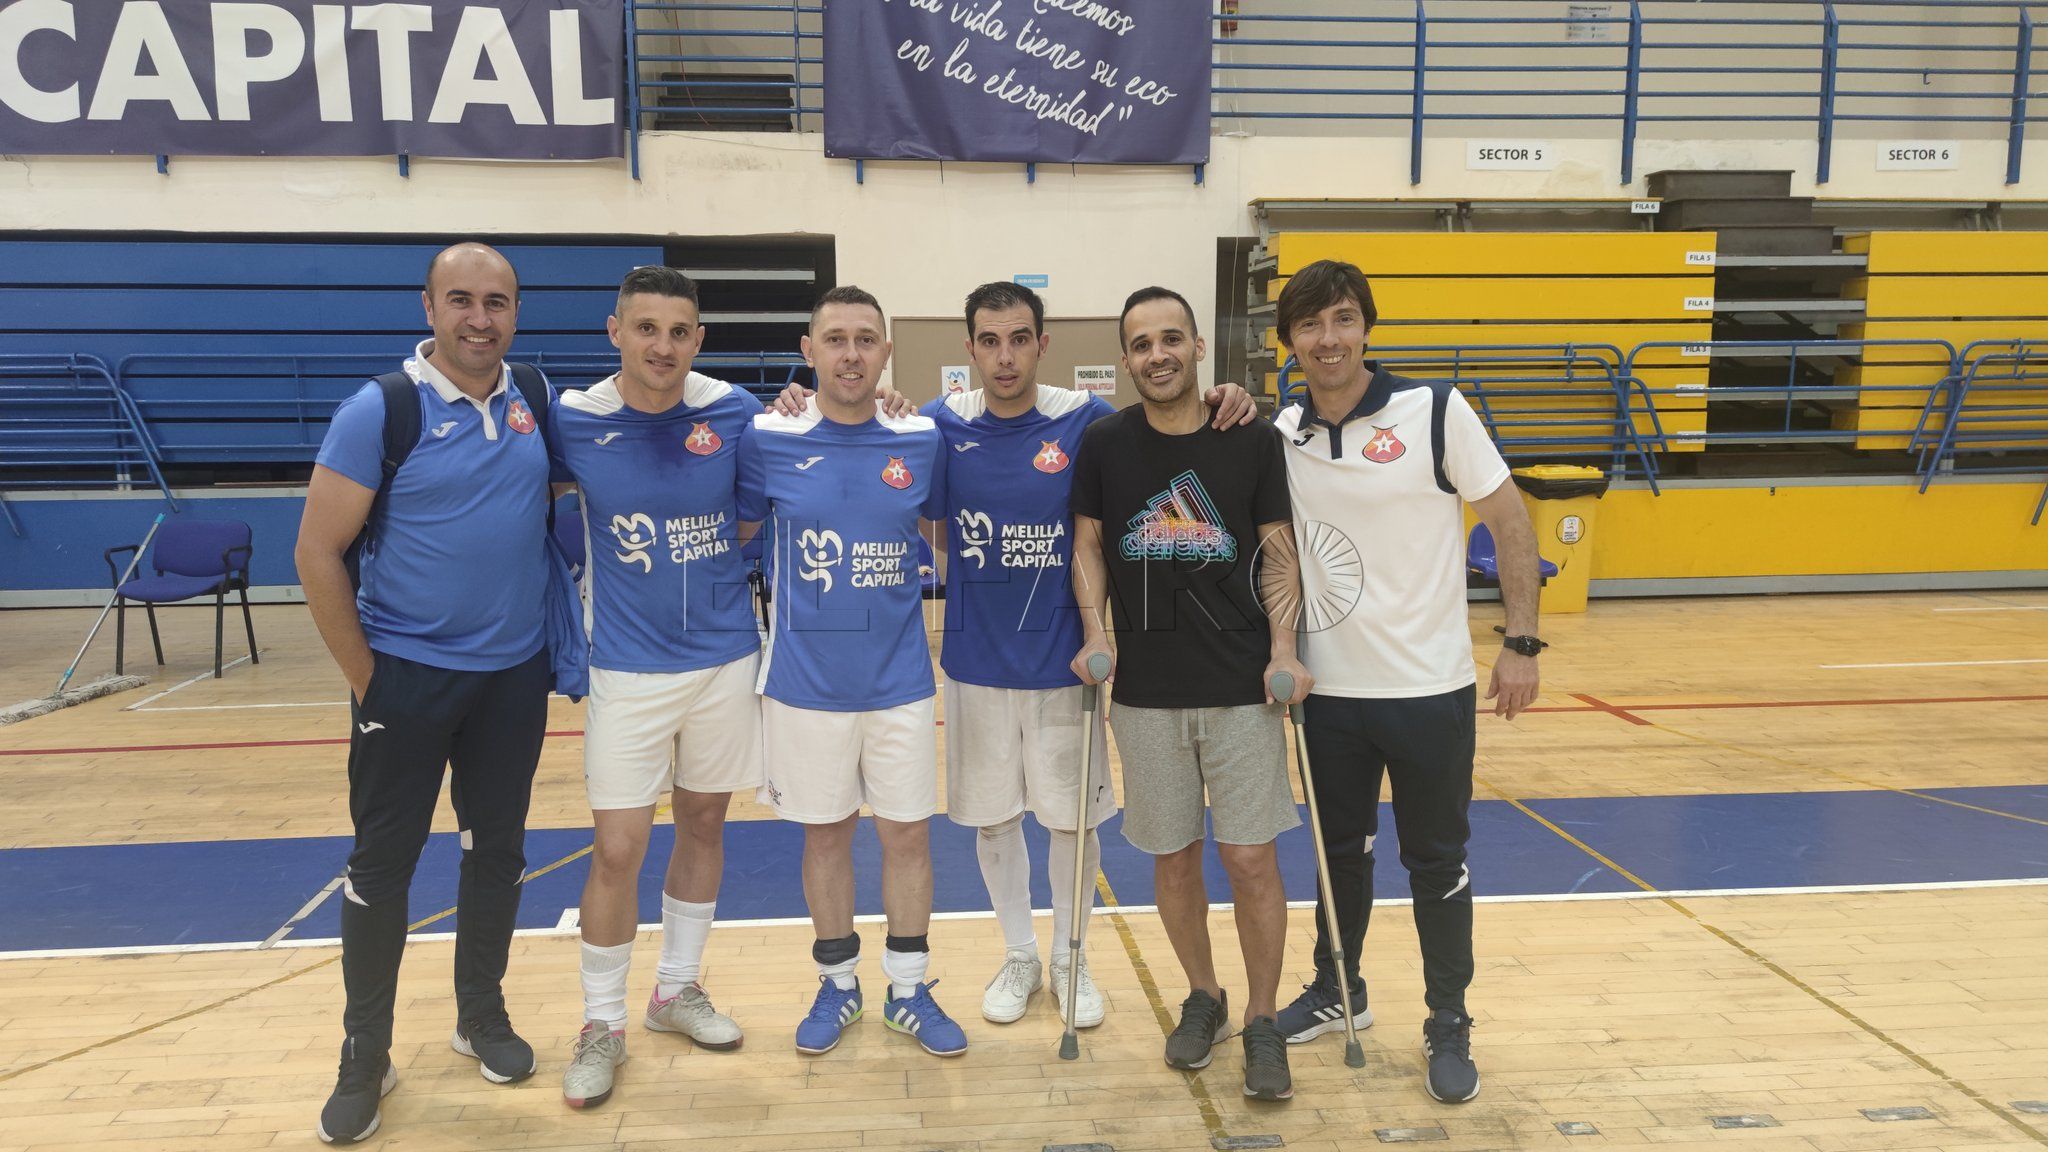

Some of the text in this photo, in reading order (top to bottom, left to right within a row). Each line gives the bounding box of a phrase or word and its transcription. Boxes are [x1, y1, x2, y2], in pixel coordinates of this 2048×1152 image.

[897, 39, 935, 71] en
[943, 37, 977, 84] la
[950, 0, 1008, 41] vida
[1015, 18, 1086, 70] tiene
[1090, 60, 1119, 88] su
[1124, 75, 1178, 105] eco
[0, 0, 615, 125] CAPITAL
[1478, 148, 1543, 161] SECTOR 5
[1888, 148, 1950, 161] SECTOR 6
[666, 511, 726, 533] MELILLA
[668, 527, 719, 549] SPORT
[1001, 524, 1065, 538] MELILLA
[671, 539, 730, 564] CAPITAL
[852, 541, 908, 557] MELILLA
[1001, 539, 1055, 553] SPORT
[852, 557, 901, 572] SPORT
[1001, 553, 1064, 568] CAPITAL
[851, 571, 905, 588] CAPITAL
